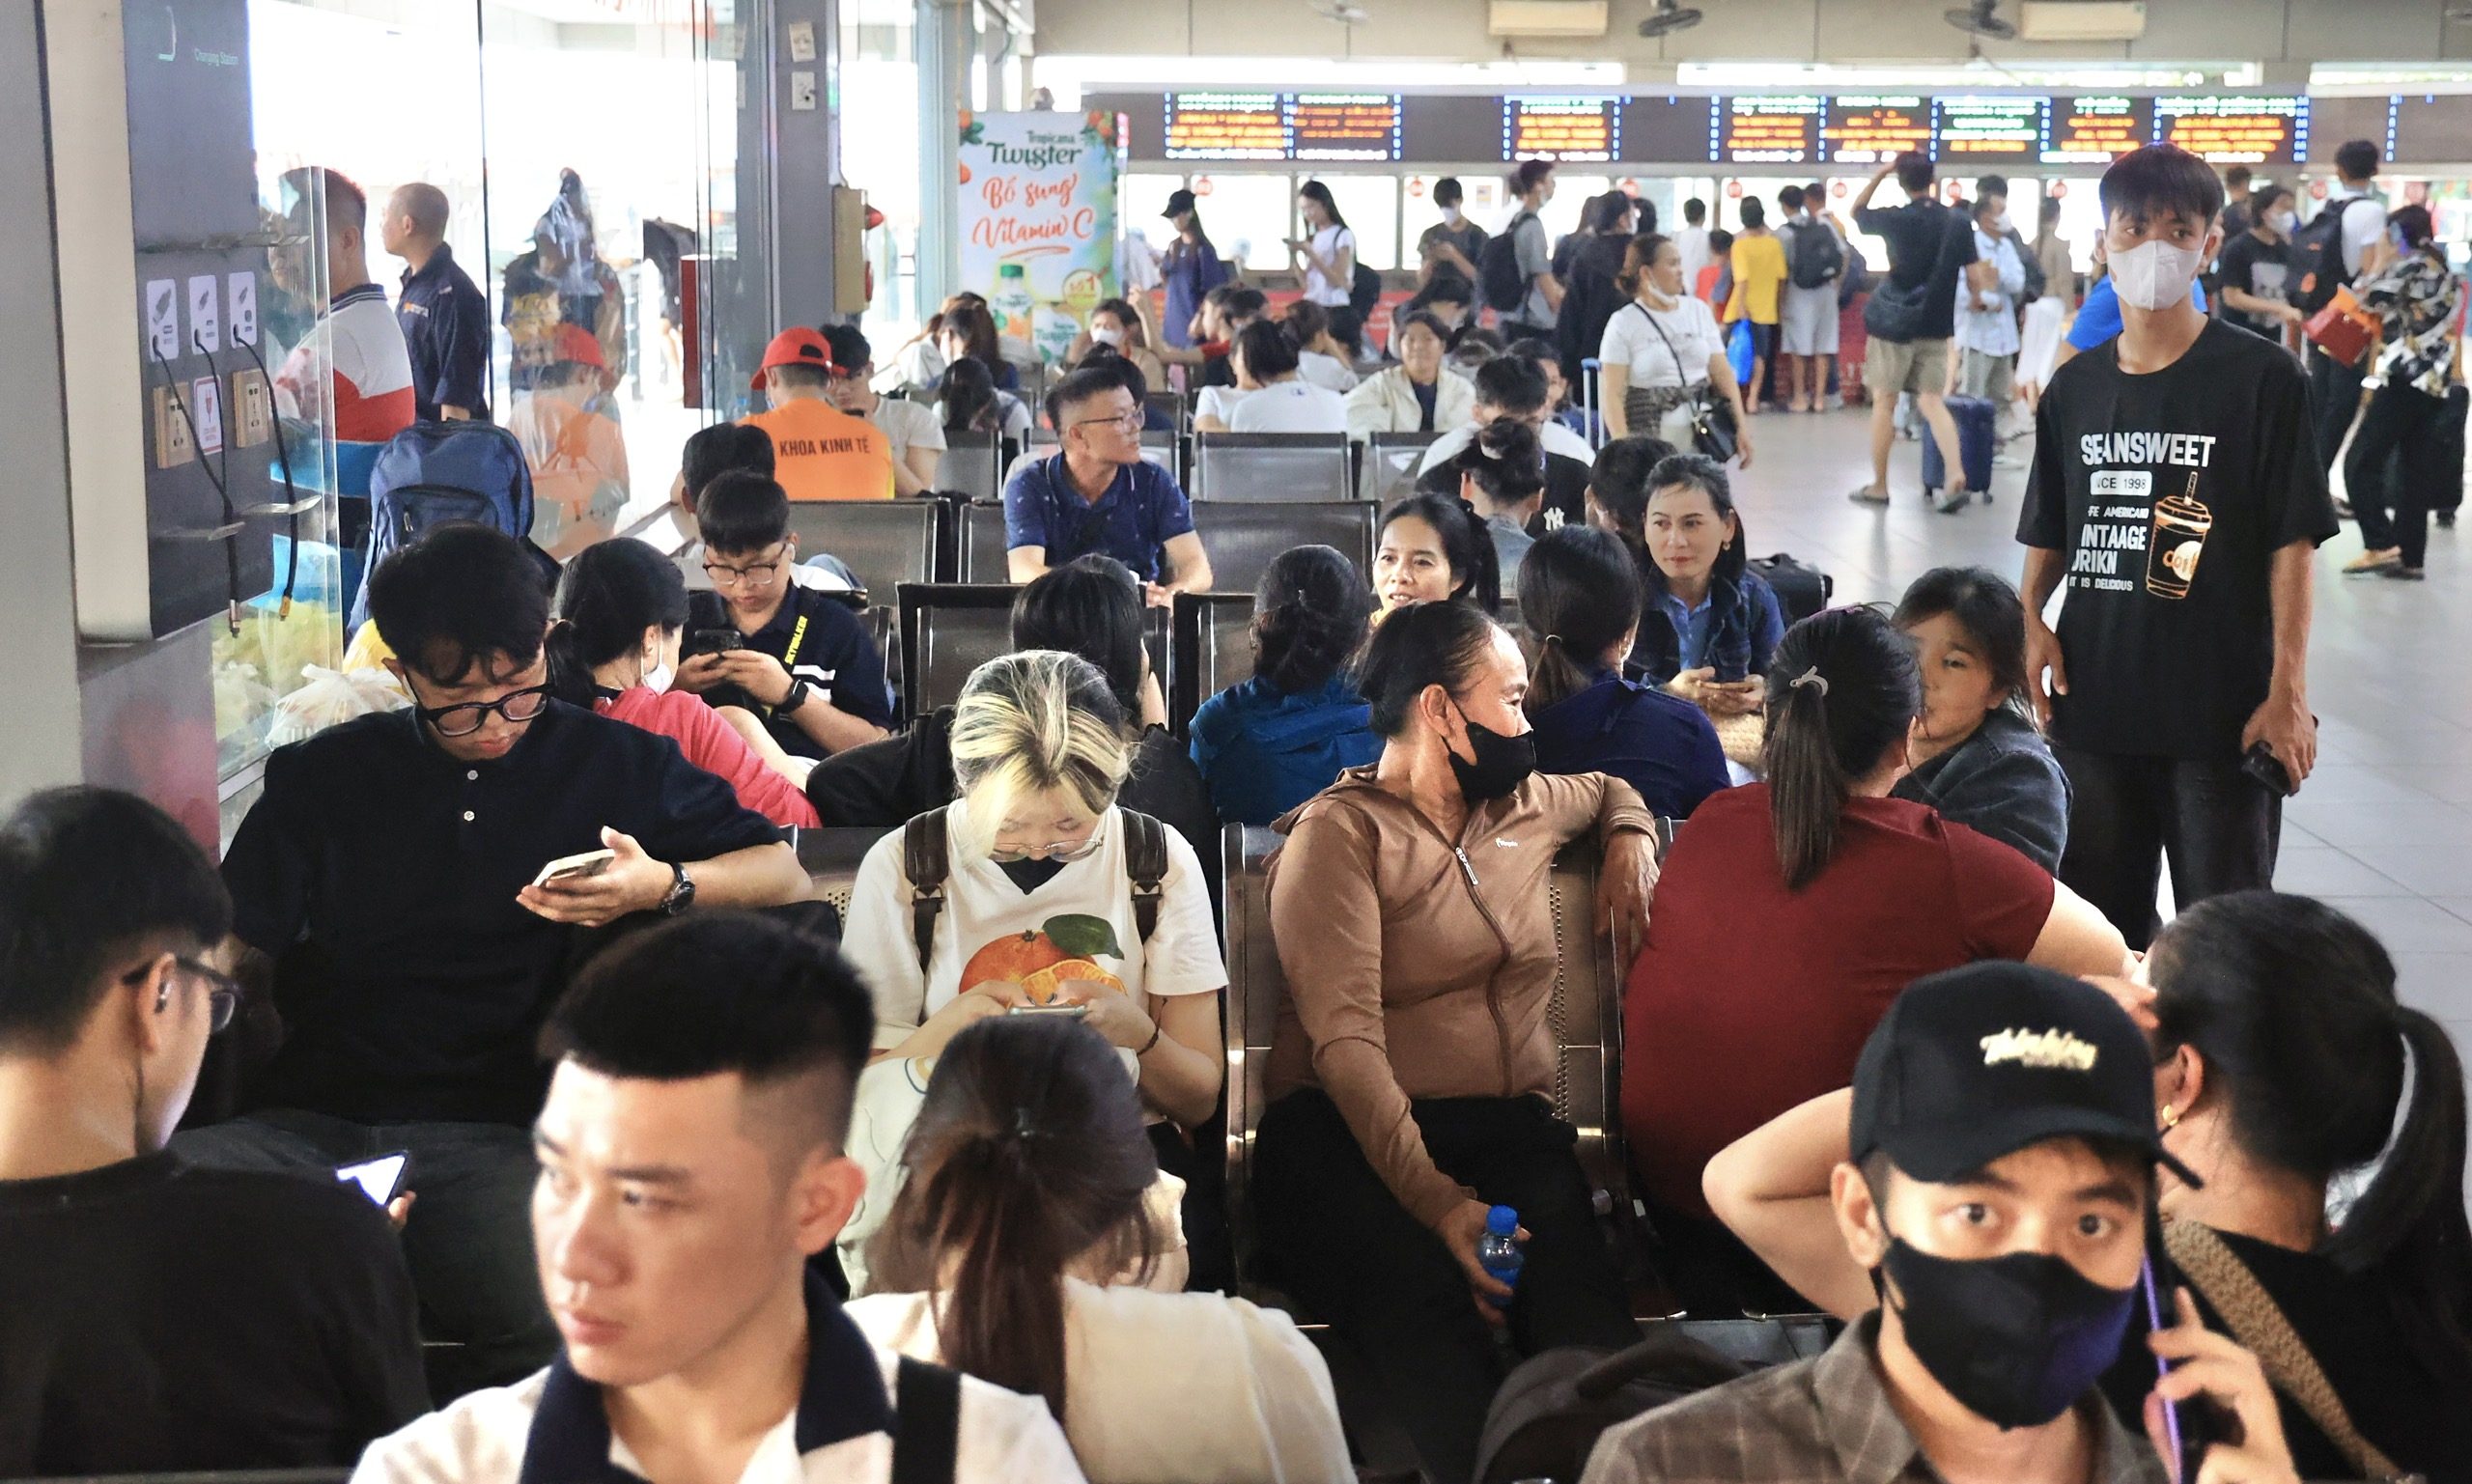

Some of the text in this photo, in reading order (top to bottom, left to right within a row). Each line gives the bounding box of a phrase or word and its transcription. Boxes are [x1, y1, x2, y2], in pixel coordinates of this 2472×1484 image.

[986, 142, 1082, 171] Twister
[1025, 173, 1079, 208] sung
[972, 208, 1094, 248] Vitamin C
[779, 440, 817, 457] KHOA
[820, 437, 854, 455] KINH
[784, 615, 808, 665] SKYWALKER
